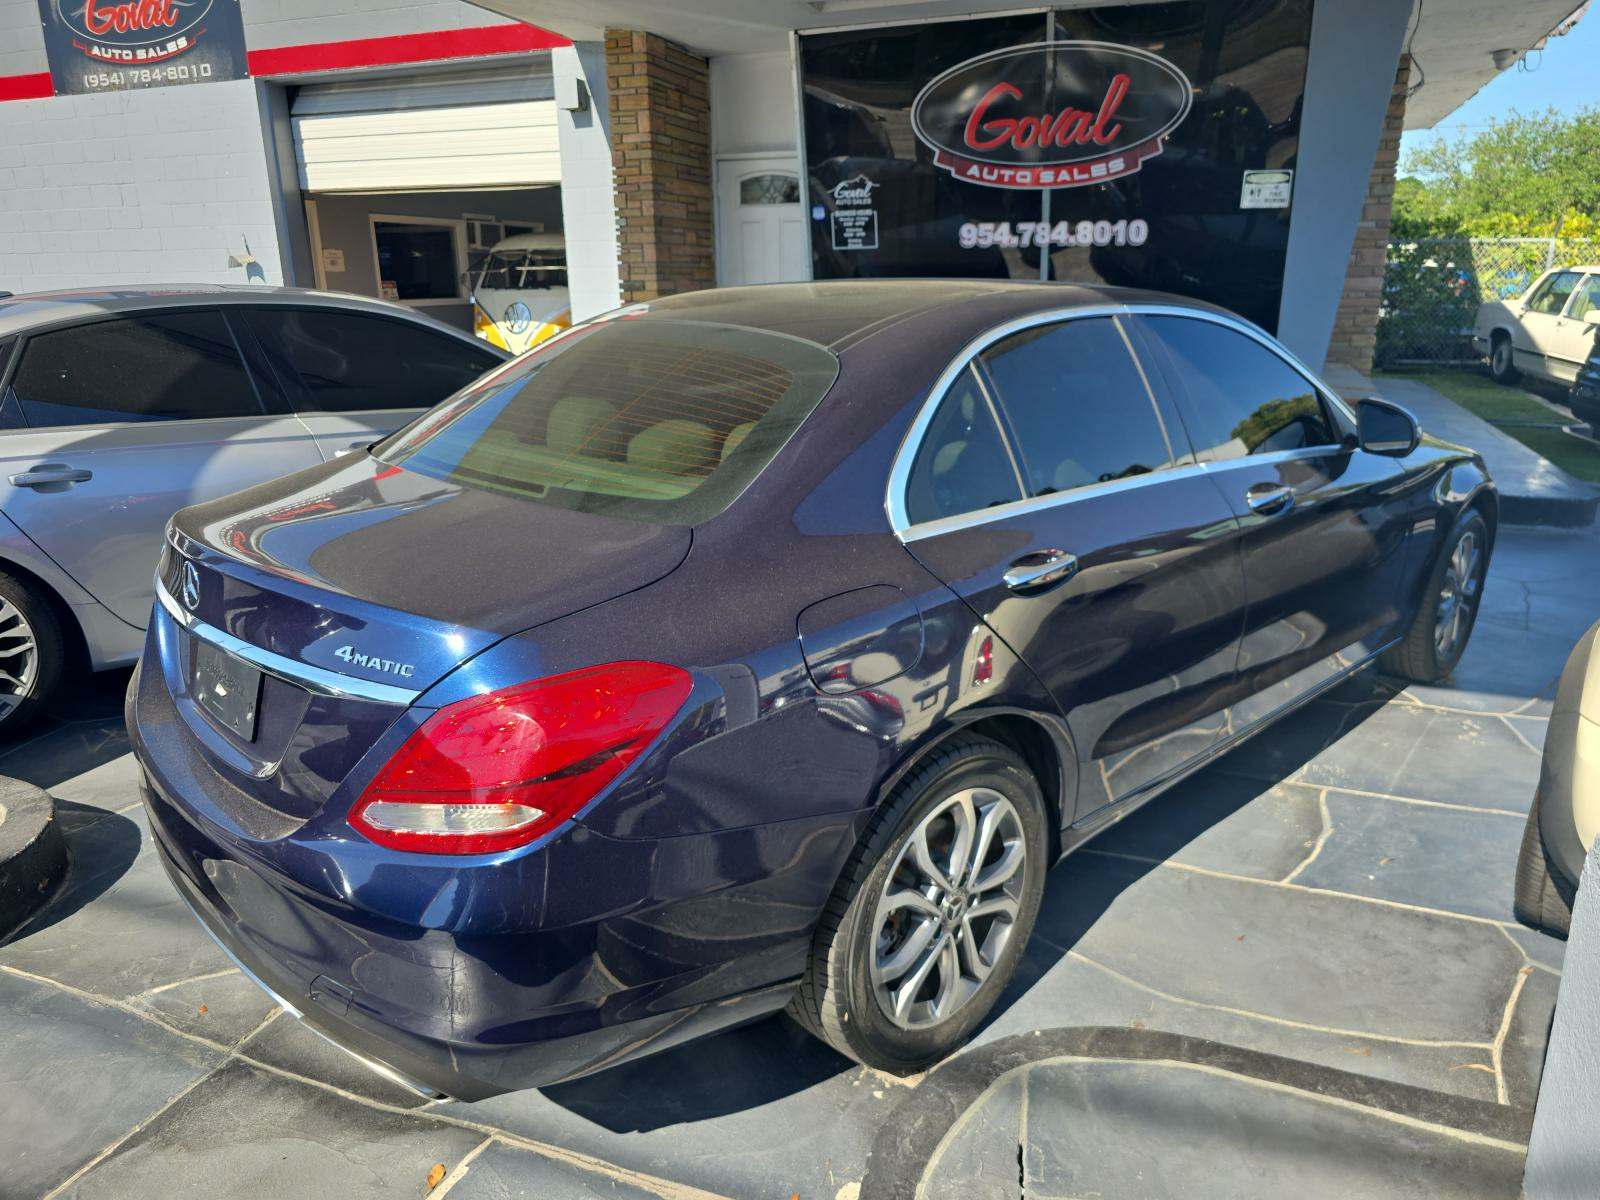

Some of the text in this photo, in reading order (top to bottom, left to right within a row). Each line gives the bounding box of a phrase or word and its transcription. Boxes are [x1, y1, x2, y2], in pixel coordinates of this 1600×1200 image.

[91, 36, 188, 60] AUTO SALES
[84, 63, 212, 88] (954) 784-8010
[964, 74, 1131, 150] Goval
[966, 158, 1126, 184] AUTO SALES
[834, 180, 872, 199] Goval
[959, 219, 1149, 249] 954.784.8010
[334, 645, 416, 678] 4MATIC
